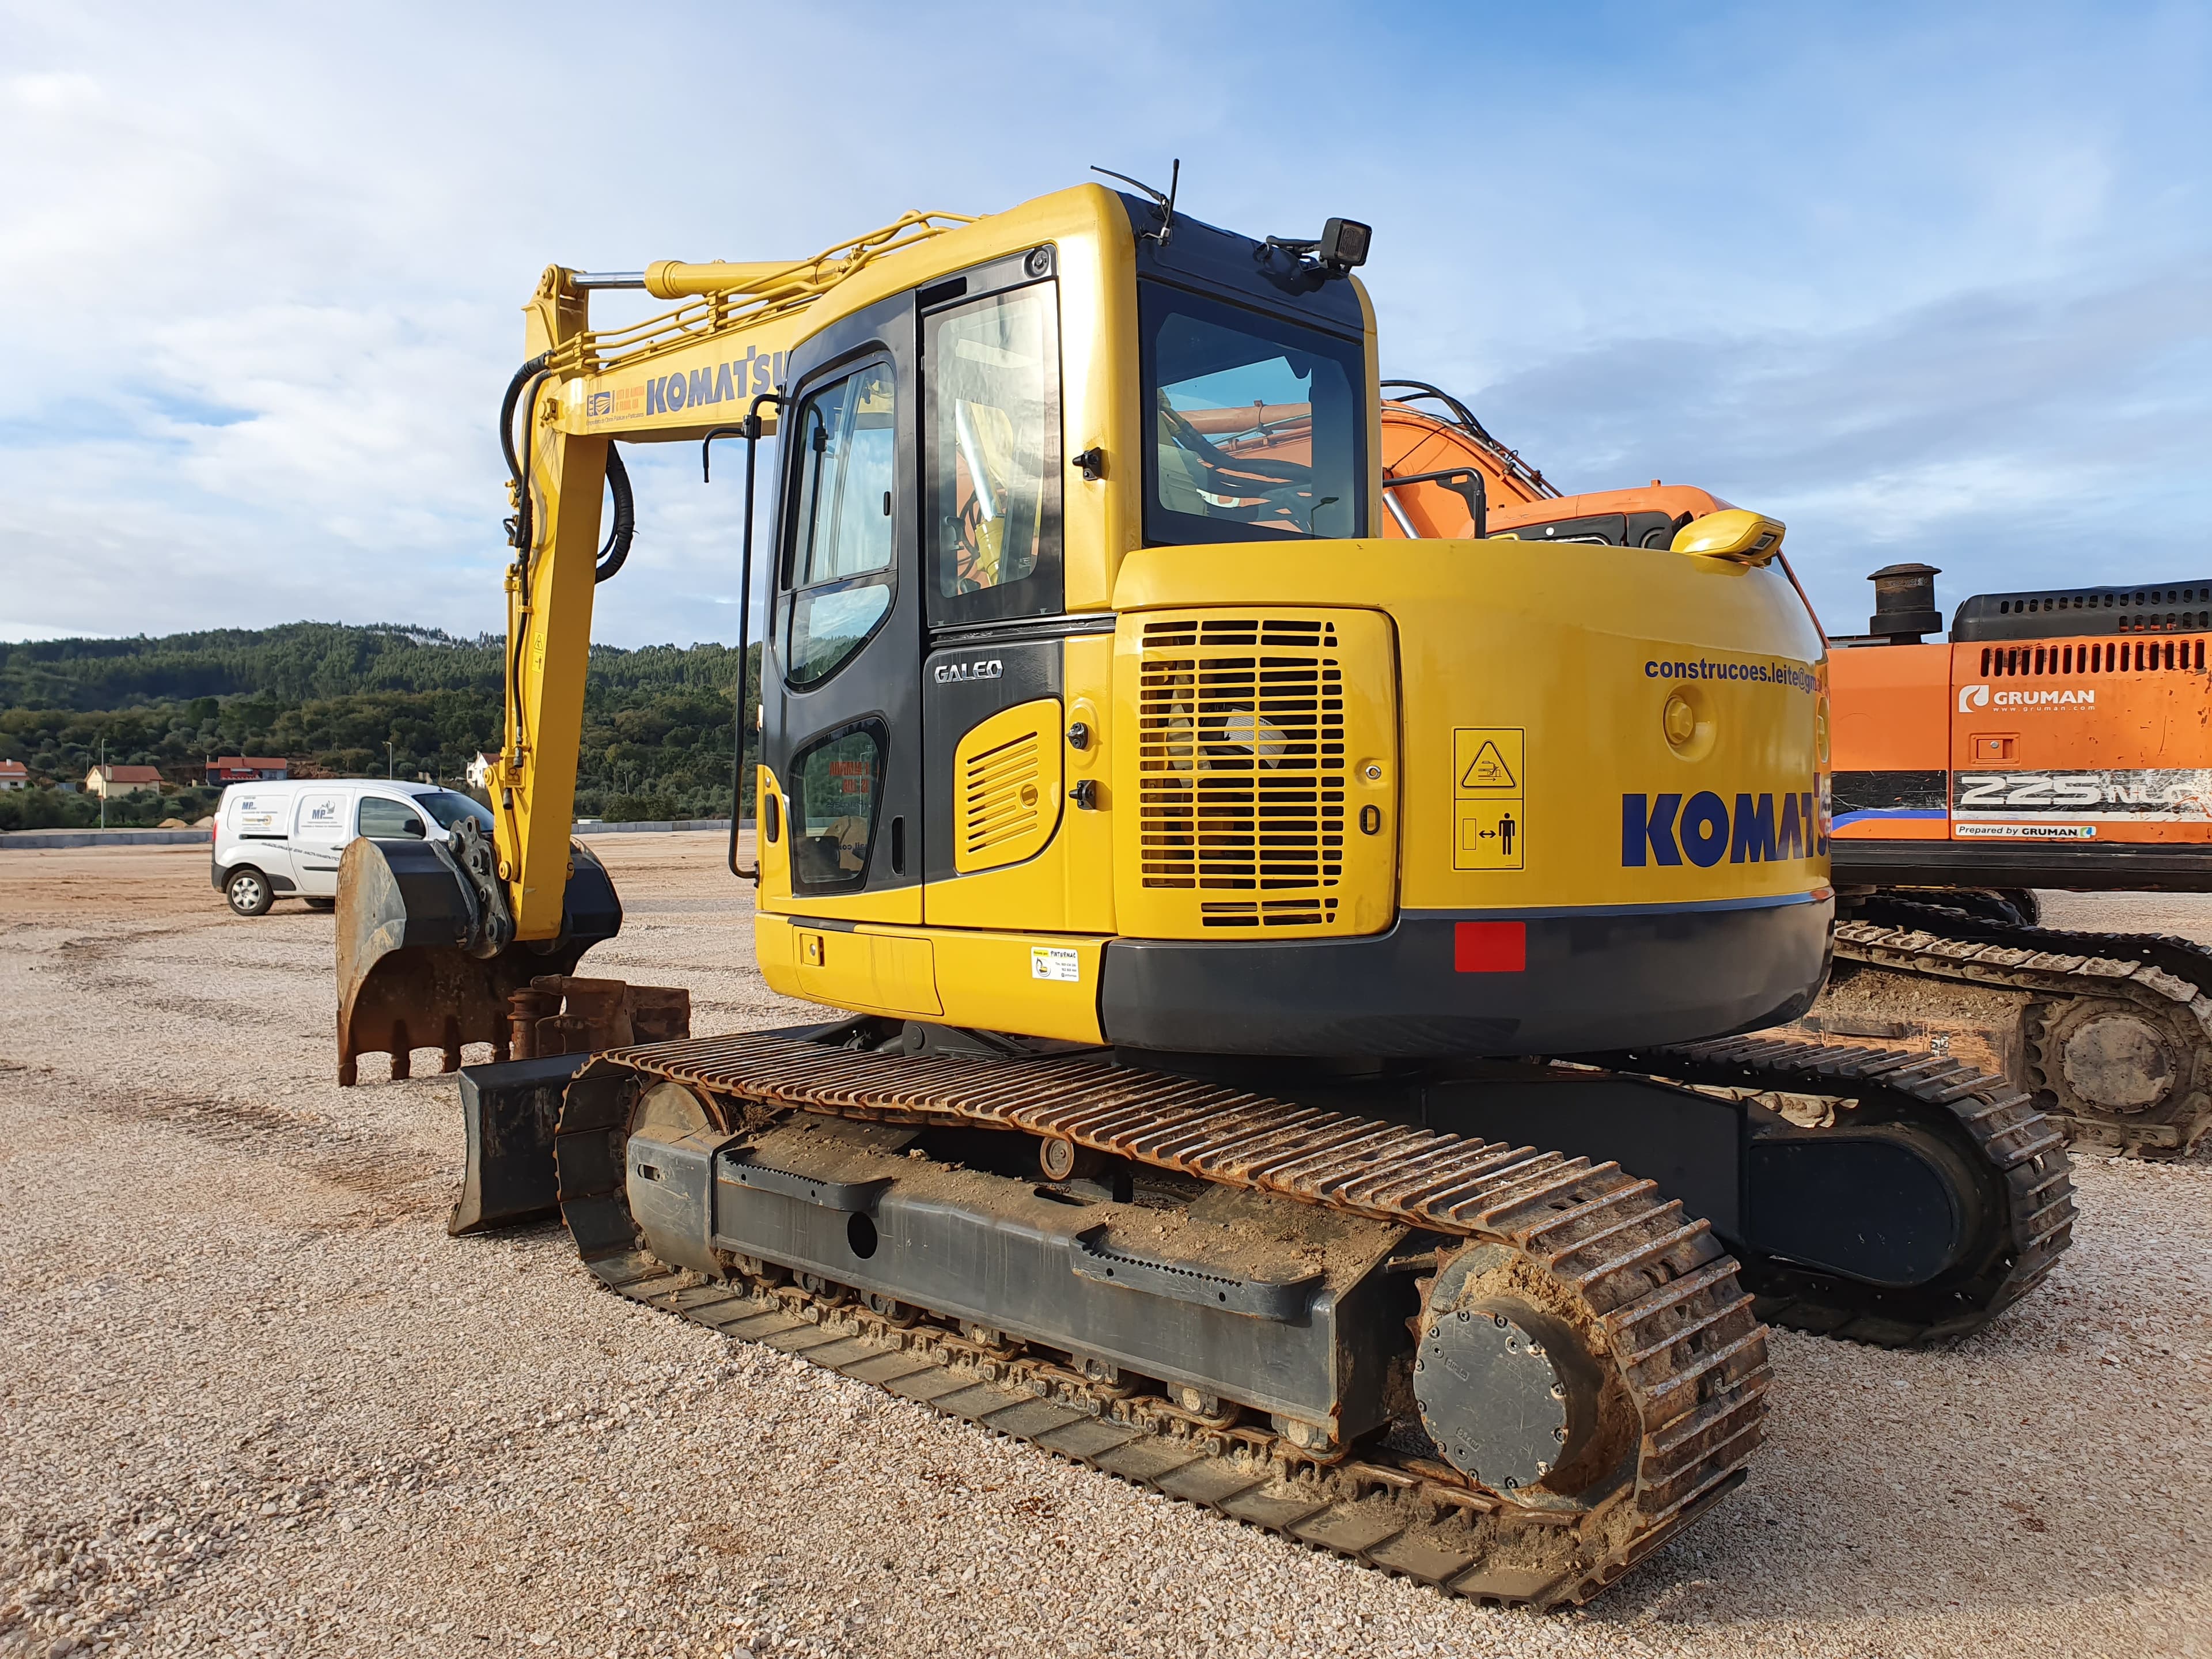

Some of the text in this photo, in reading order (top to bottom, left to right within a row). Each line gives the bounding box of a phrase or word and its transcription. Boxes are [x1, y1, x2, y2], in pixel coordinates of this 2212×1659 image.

[934, 660, 1003, 684] GALEO
[1994, 690, 2095, 705] GRUMAN
[1959, 826, 2003, 834] Prepared
[2022, 828, 2077, 836] GRUMAN
